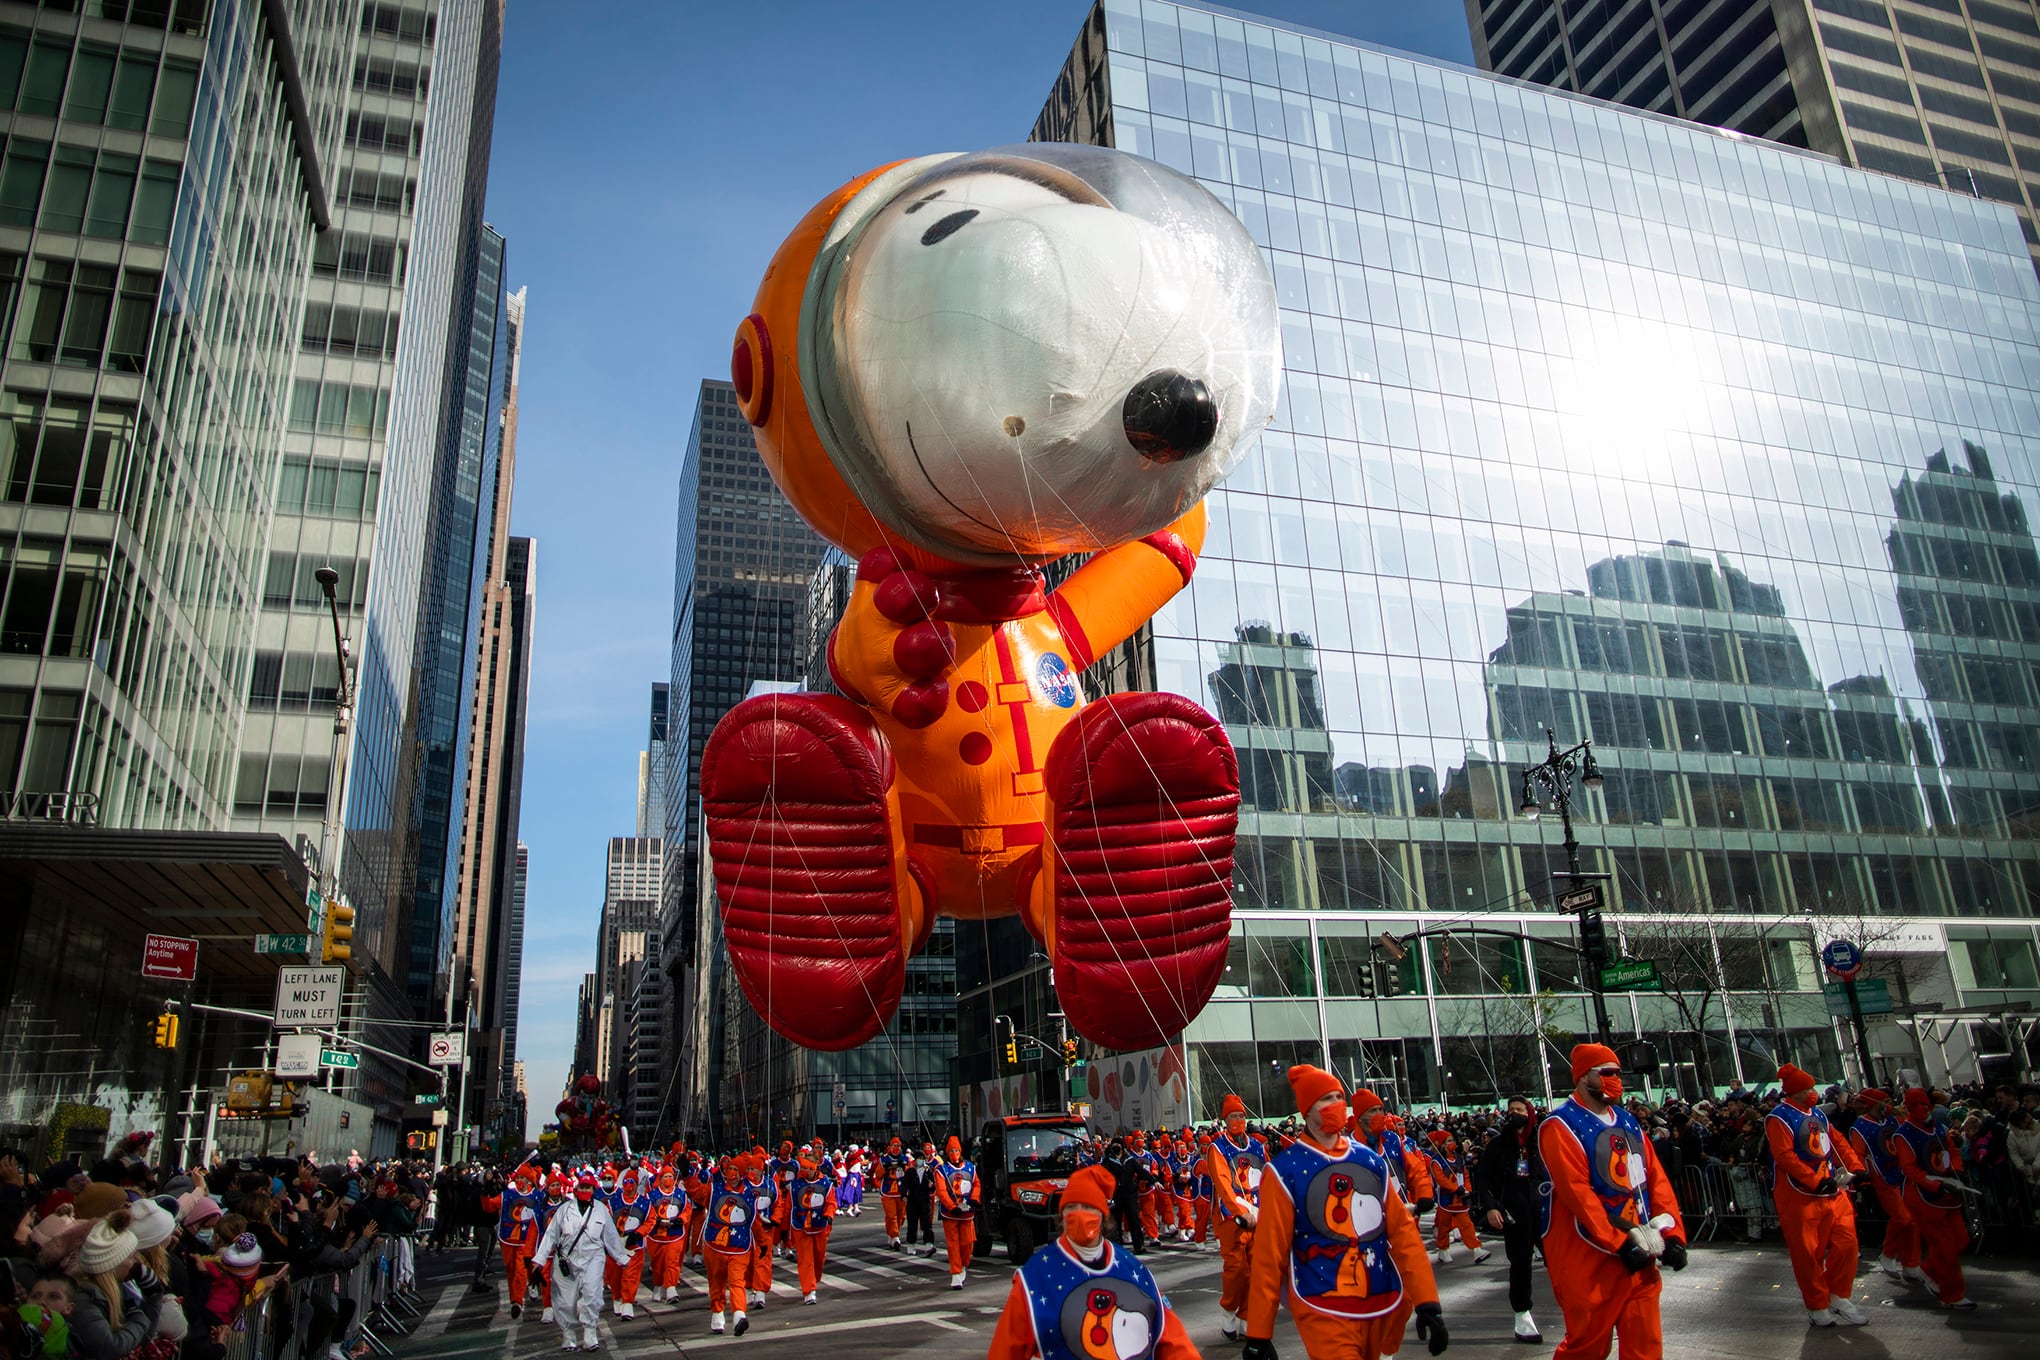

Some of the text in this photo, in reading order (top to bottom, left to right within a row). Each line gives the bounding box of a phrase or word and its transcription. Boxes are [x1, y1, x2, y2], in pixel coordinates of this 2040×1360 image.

[1041, 673, 1074, 690] NASA
[1565, 893, 1590, 907] ONE WAY
[149, 939, 190, 952] NO STOPPING
[270, 938, 278, 951] W
[281, 937, 296, 951] 42
[299, 938, 306, 946] St
[148, 948, 174, 959] Anytime
[284, 974, 338, 984] LEFT LANE
[1617, 967, 1651, 982] Americas
[292, 990, 326, 1002] MUST
[281, 1008, 334, 1019] TURN LEFT
